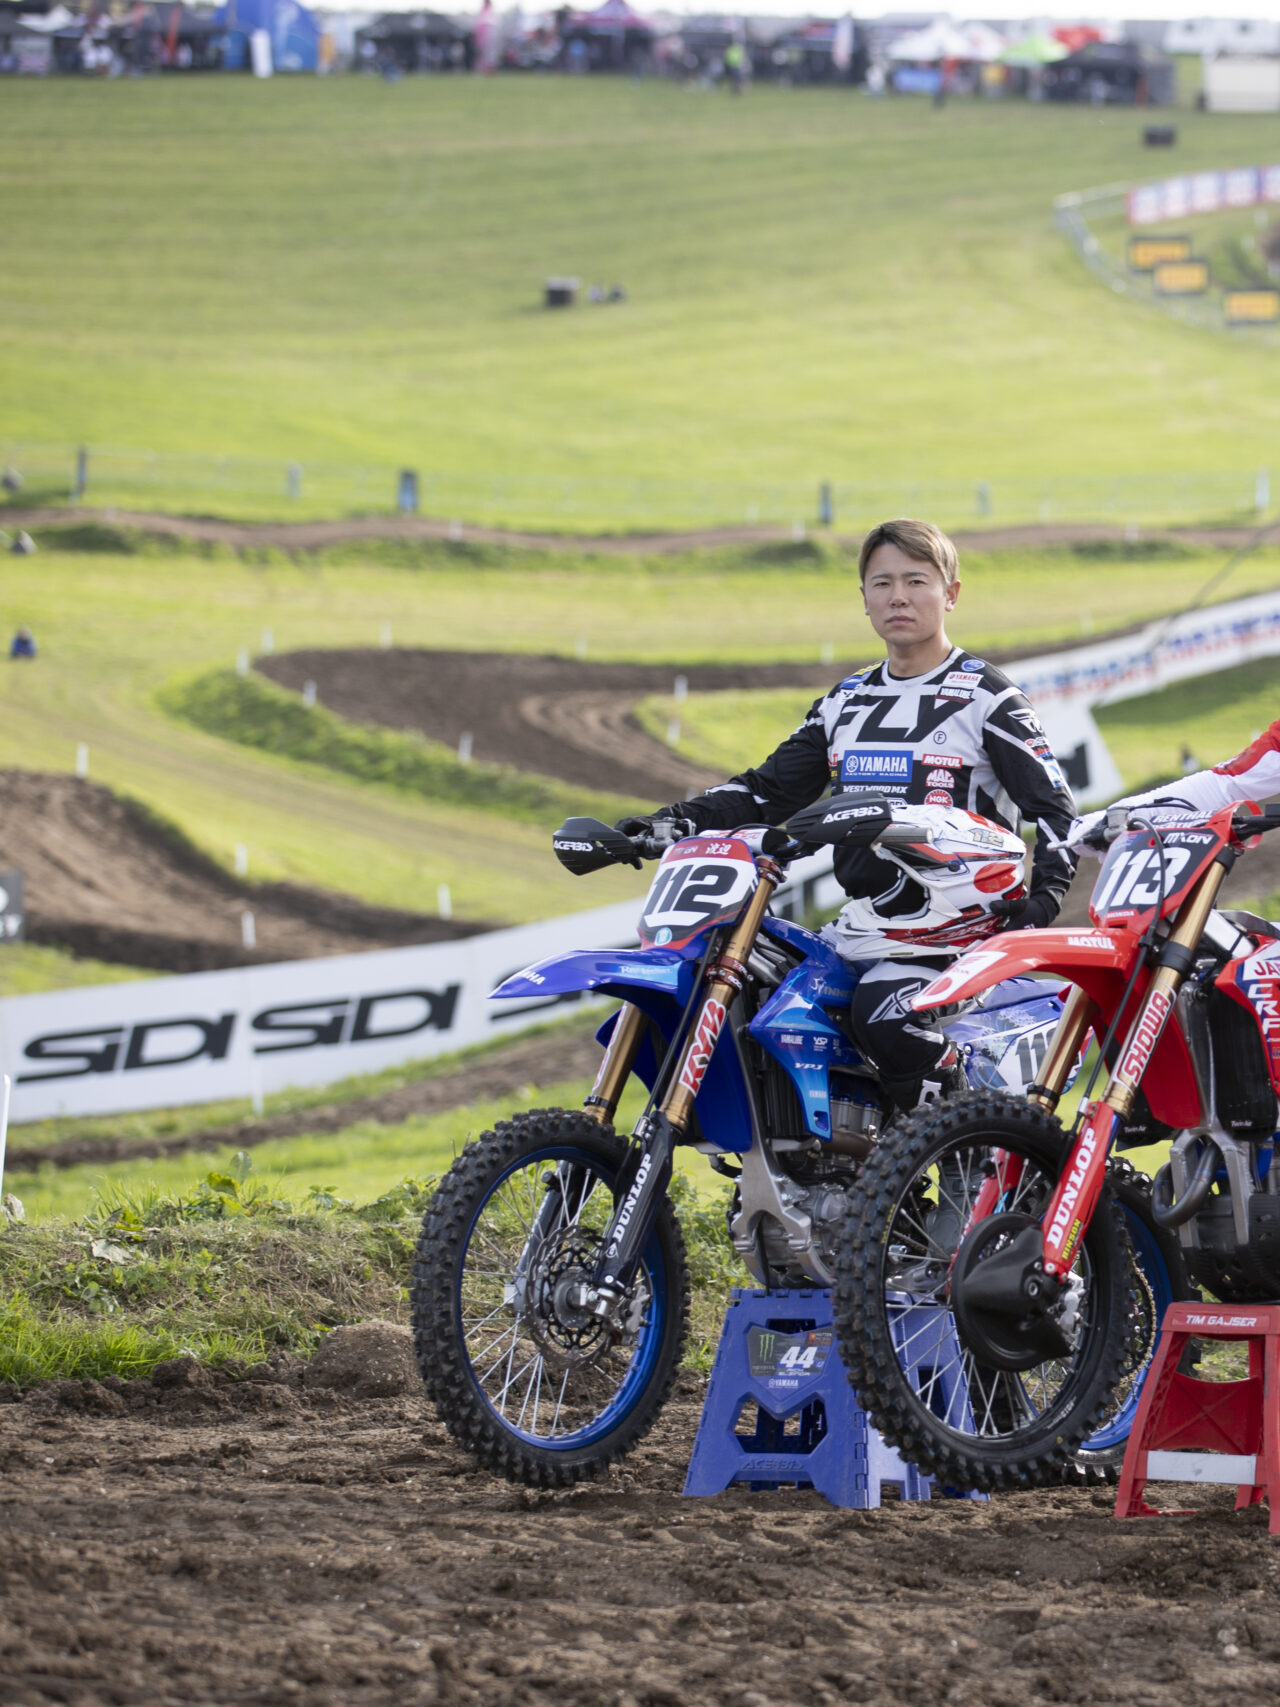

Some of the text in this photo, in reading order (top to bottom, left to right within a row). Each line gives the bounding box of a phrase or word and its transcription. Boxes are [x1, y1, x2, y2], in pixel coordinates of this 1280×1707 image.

[829, 694, 975, 746] FLY
[860, 757, 908, 773] YAMAHA
[923, 755, 961, 767] MOTUL
[843, 785, 891, 793] WESTWOOD
[930, 796, 948, 804] NGK
[822, 806, 884, 824] ACERBIS
[1152, 811, 1213, 823] RENTHAL
[553, 840, 594, 852] ACERBIS
[1094, 847, 1191, 912] 113
[643, 864, 738, 916] 112
[1068, 937, 1115, 949] MOTUL
[1123, 991, 1170, 1085] SHOWA
[1046, 1127, 1097, 1248] DUNLOP
[614, 1153, 652, 1243] DUNLOP
[1062, 1219, 1082, 1261] HINSON
[1185, 1315, 1257, 1327] TIM GAJSER
[780, 1346, 818, 1369] 44
